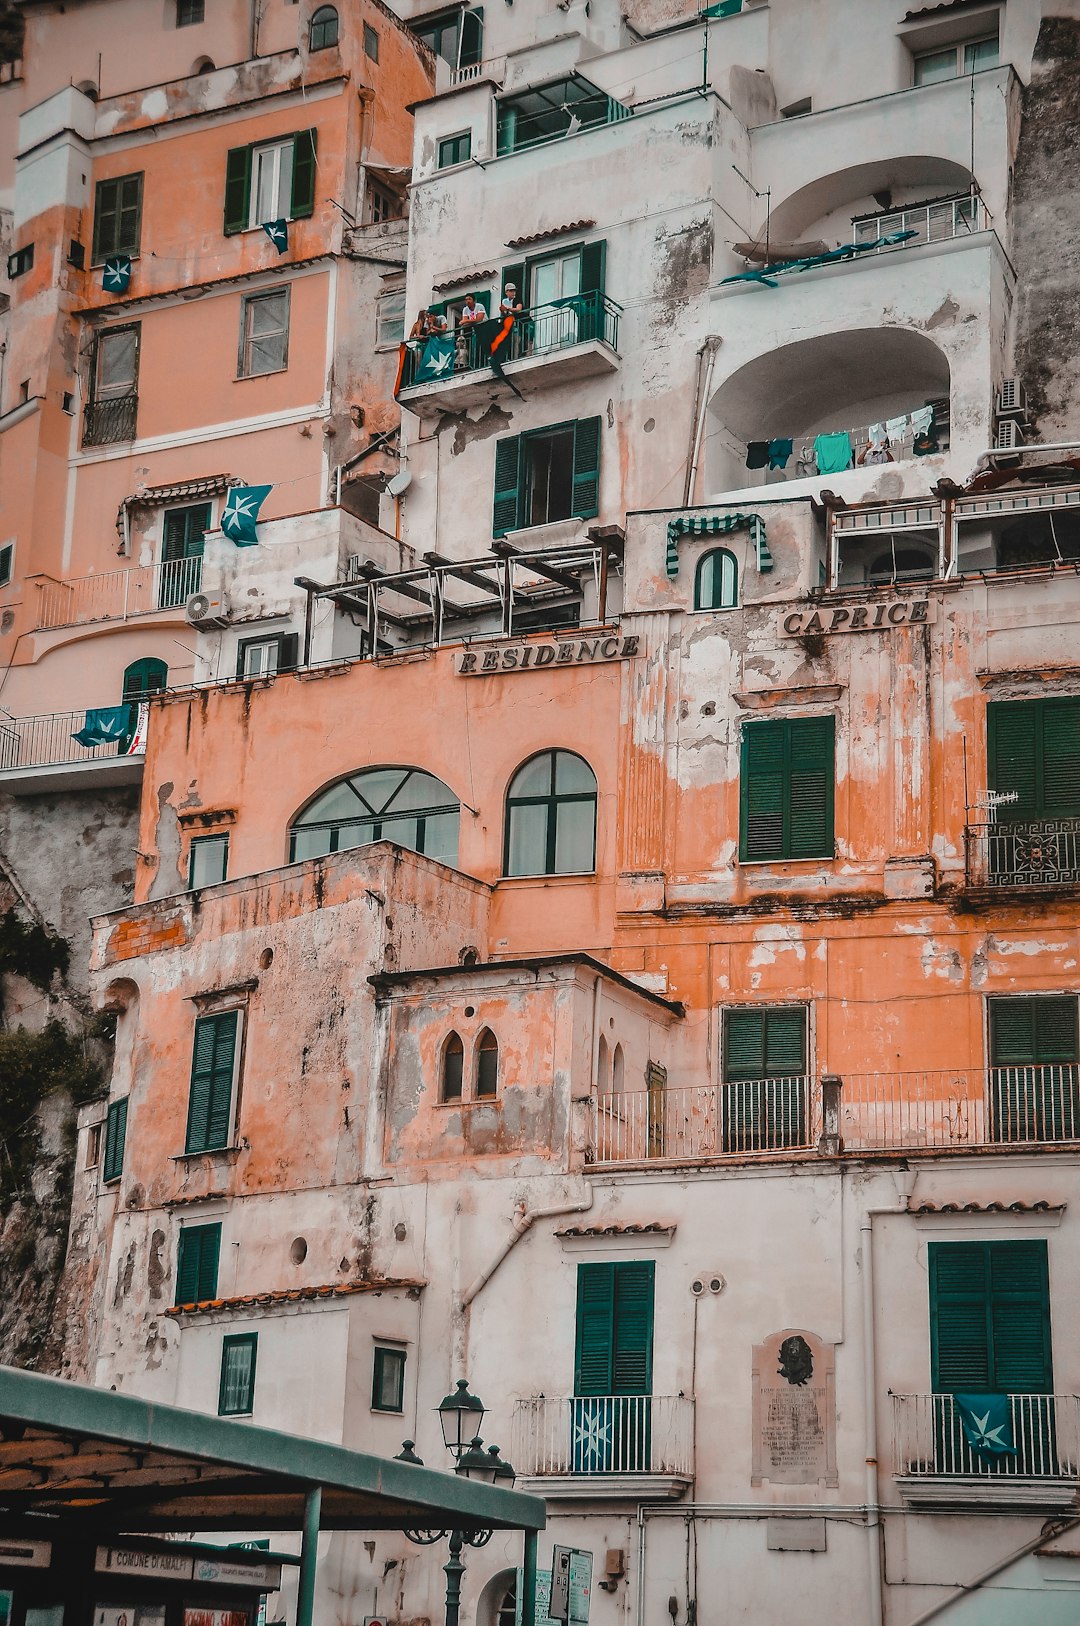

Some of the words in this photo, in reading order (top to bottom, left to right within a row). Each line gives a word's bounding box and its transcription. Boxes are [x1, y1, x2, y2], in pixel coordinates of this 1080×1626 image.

[783, 601, 929, 634] CAPRICE
[458, 635, 640, 673] RESIDENCE
[116, 1551, 149, 1568] COMUNE
[151, 1555, 159, 1569] DI
[159, 1556, 187, 1571] AMALFI
